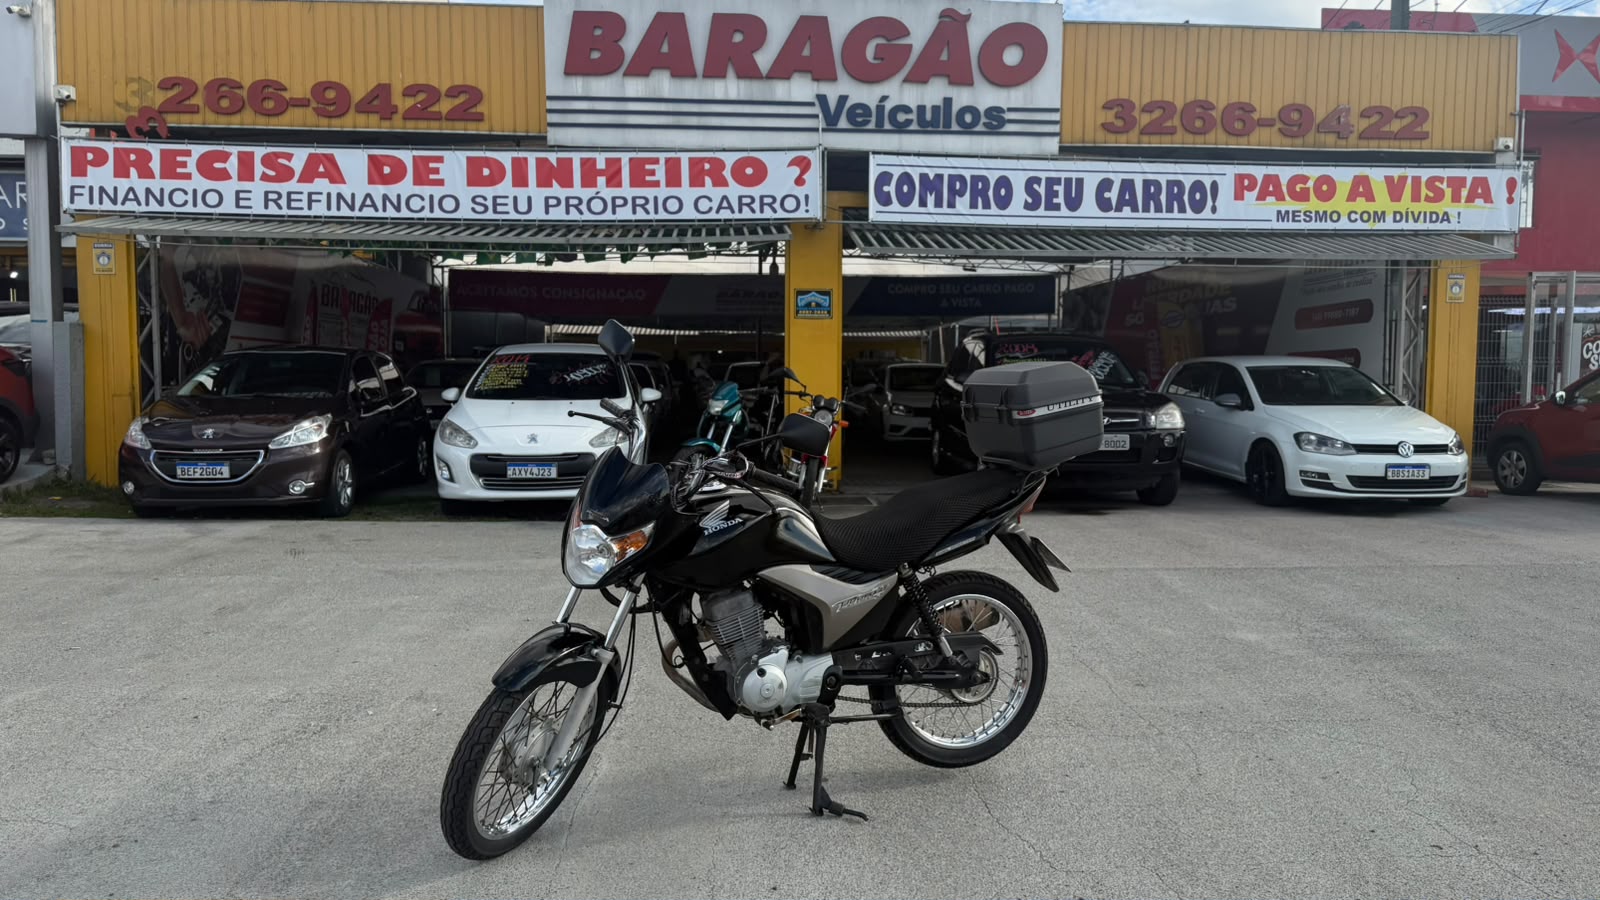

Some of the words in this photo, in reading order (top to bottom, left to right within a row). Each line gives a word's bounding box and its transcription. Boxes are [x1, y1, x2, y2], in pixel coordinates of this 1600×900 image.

[563, 7, 1049, 87] BARAGÃO
[815, 94, 1007, 130] Veículos
[1101, 98, 1430, 140] 3266-9422
[70, 145, 347, 185] PRECISA
[367, 154, 445, 187] DE
[466, 155, 768, 188] DINHEIRO
[786, 155, 812, 187] ?
[874, 171, 1013, 211] COMPRO
[1023, 175, 1084, 213] SEU
[1095, 177, 1219, 215] CARRO!
[1233, 173, 1337, 203] PAGO
[1346, 174, 1376, 203] A
[1384, 175, 1494, 204] VISTA
[1506, 176, 1518, 205] !
[69, 185, 224, 209] FINANCIO
[234, 189, 253, 209] E
[263, 190, 460, 214] REFINANCIO
[470, 194, 533, 215] SEU
[544, 191, 684, 216] PRÓPRIO
[693, 194, 810, 215] CARRO!
[1276, 209, 1341, 223] MESMO
[1347, 210, 1386, 224] COM
[1392, 207, 1450, 224] DÍVIDA
[1456, 211, 1462, 224] !
[887, 283, 936, 295] COMPRO
[940, 283, 961, 294] SEU
[963, 282, 1001, 294] CARRO
[1004, 282, 1035, 293] PAGO
[949, 298, 983, 307] VISTA
[1104, 440, 1127, 449] 8002
[180, 466, 224, 477] BEF2G04
[511, 467, 552, 478] AXY4J23
[1391, 469, 1426, 479] BBS1A33
[703, 517, 744, 537] HONDA
